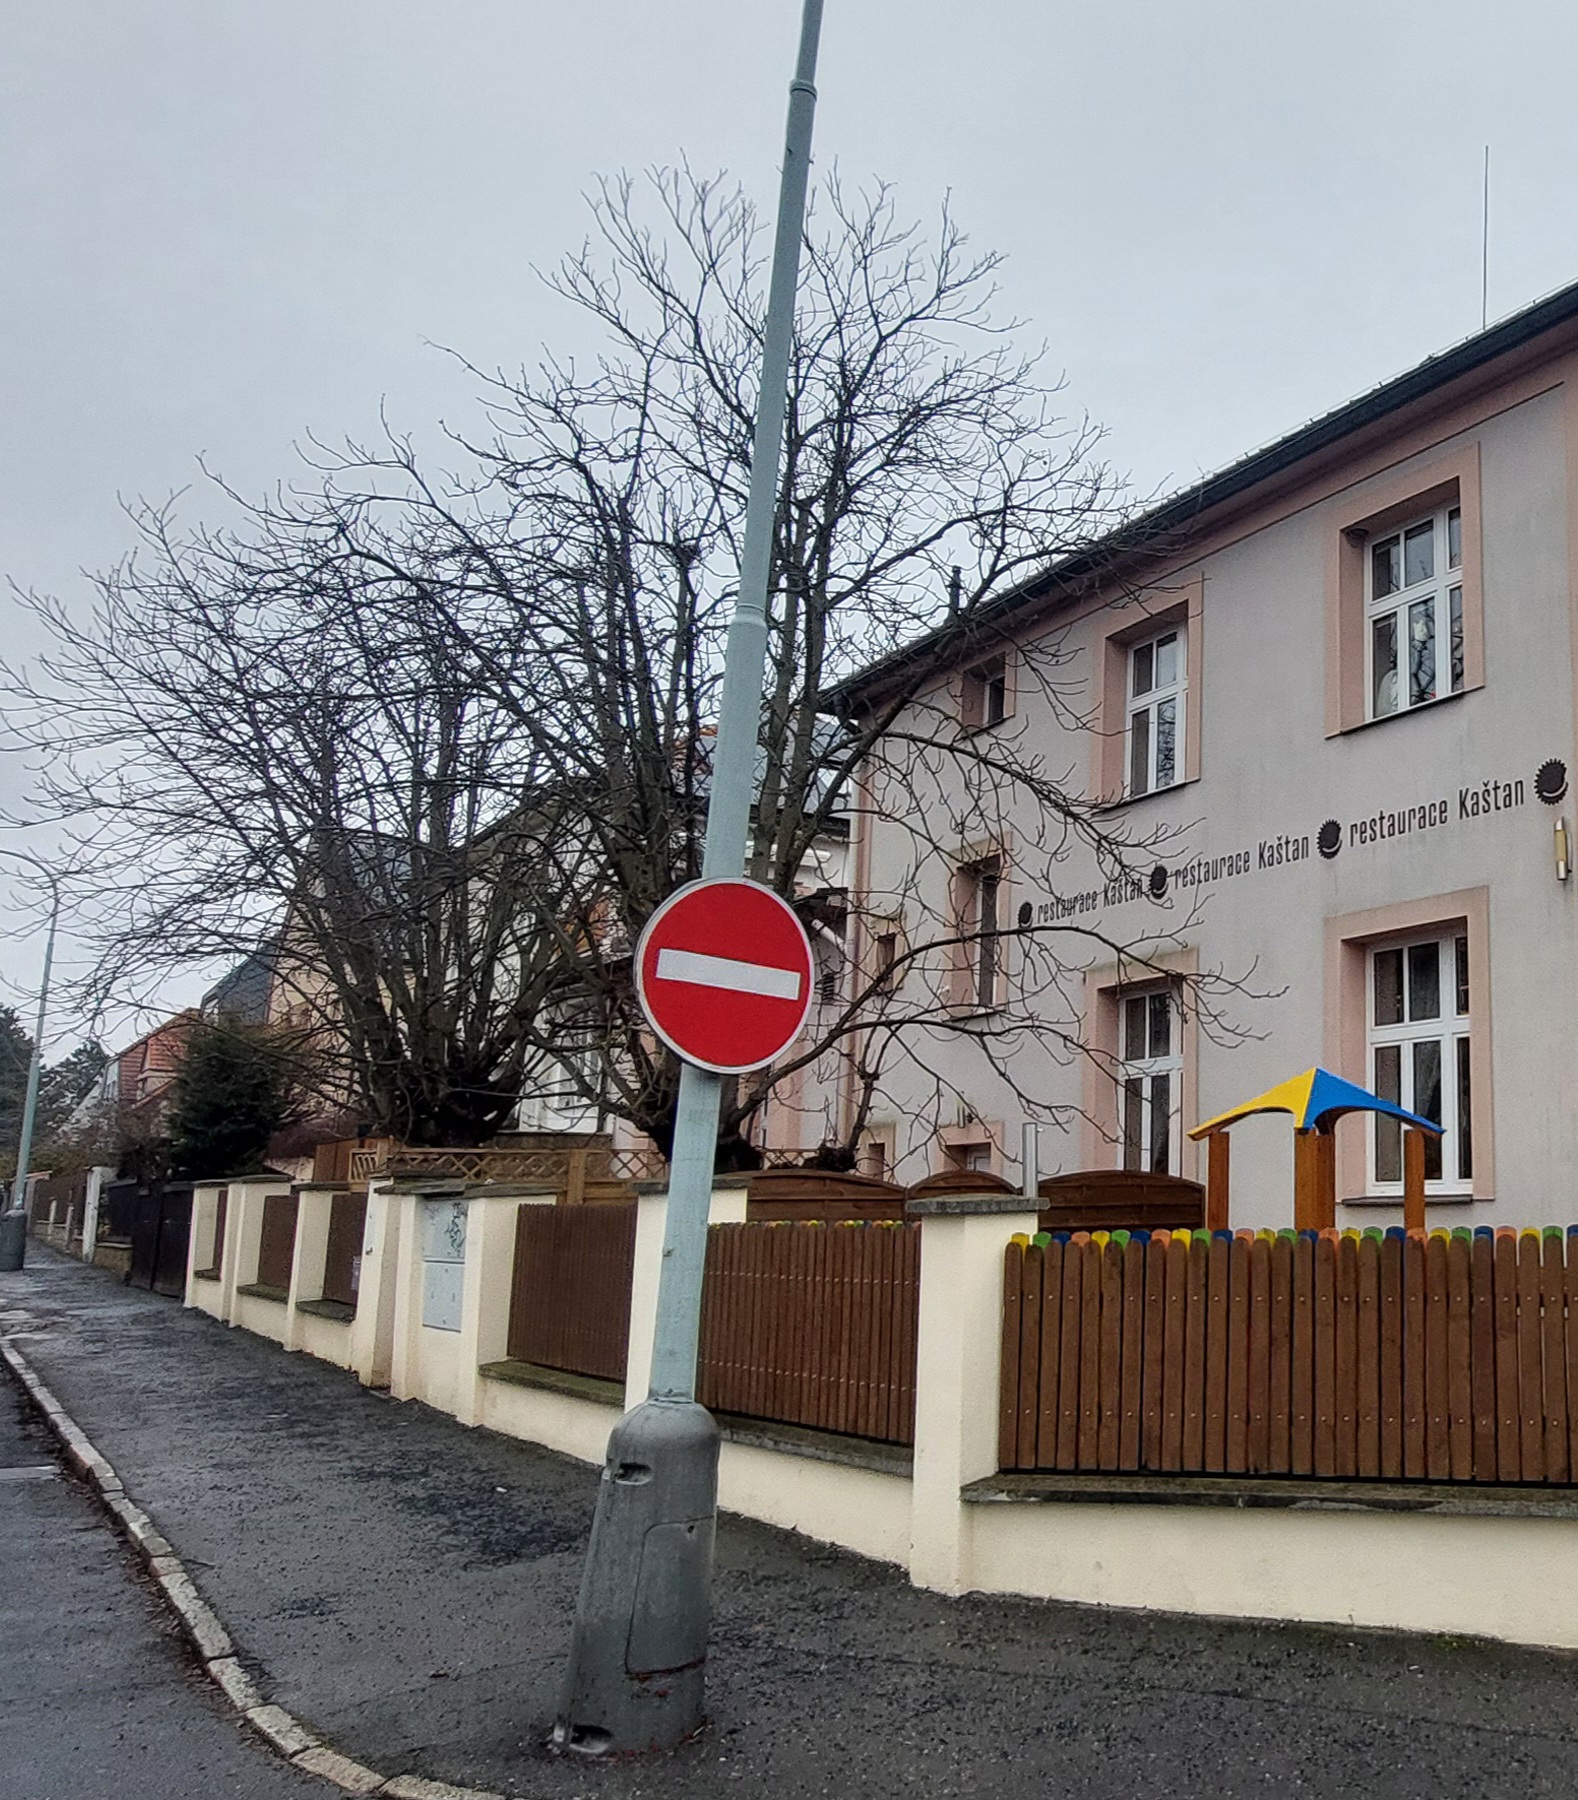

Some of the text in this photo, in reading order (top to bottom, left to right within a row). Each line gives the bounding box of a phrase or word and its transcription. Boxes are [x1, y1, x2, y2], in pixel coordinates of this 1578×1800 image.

[1037, 890, 1097, 924] restaurace
[1175, 851, 1250, 890] restaurace
[1258, 835, 1309, 870] Kaštan
[1350, 799, 1448, 848] restaurace
[1458, 779, 1525, 820] Kaštan
